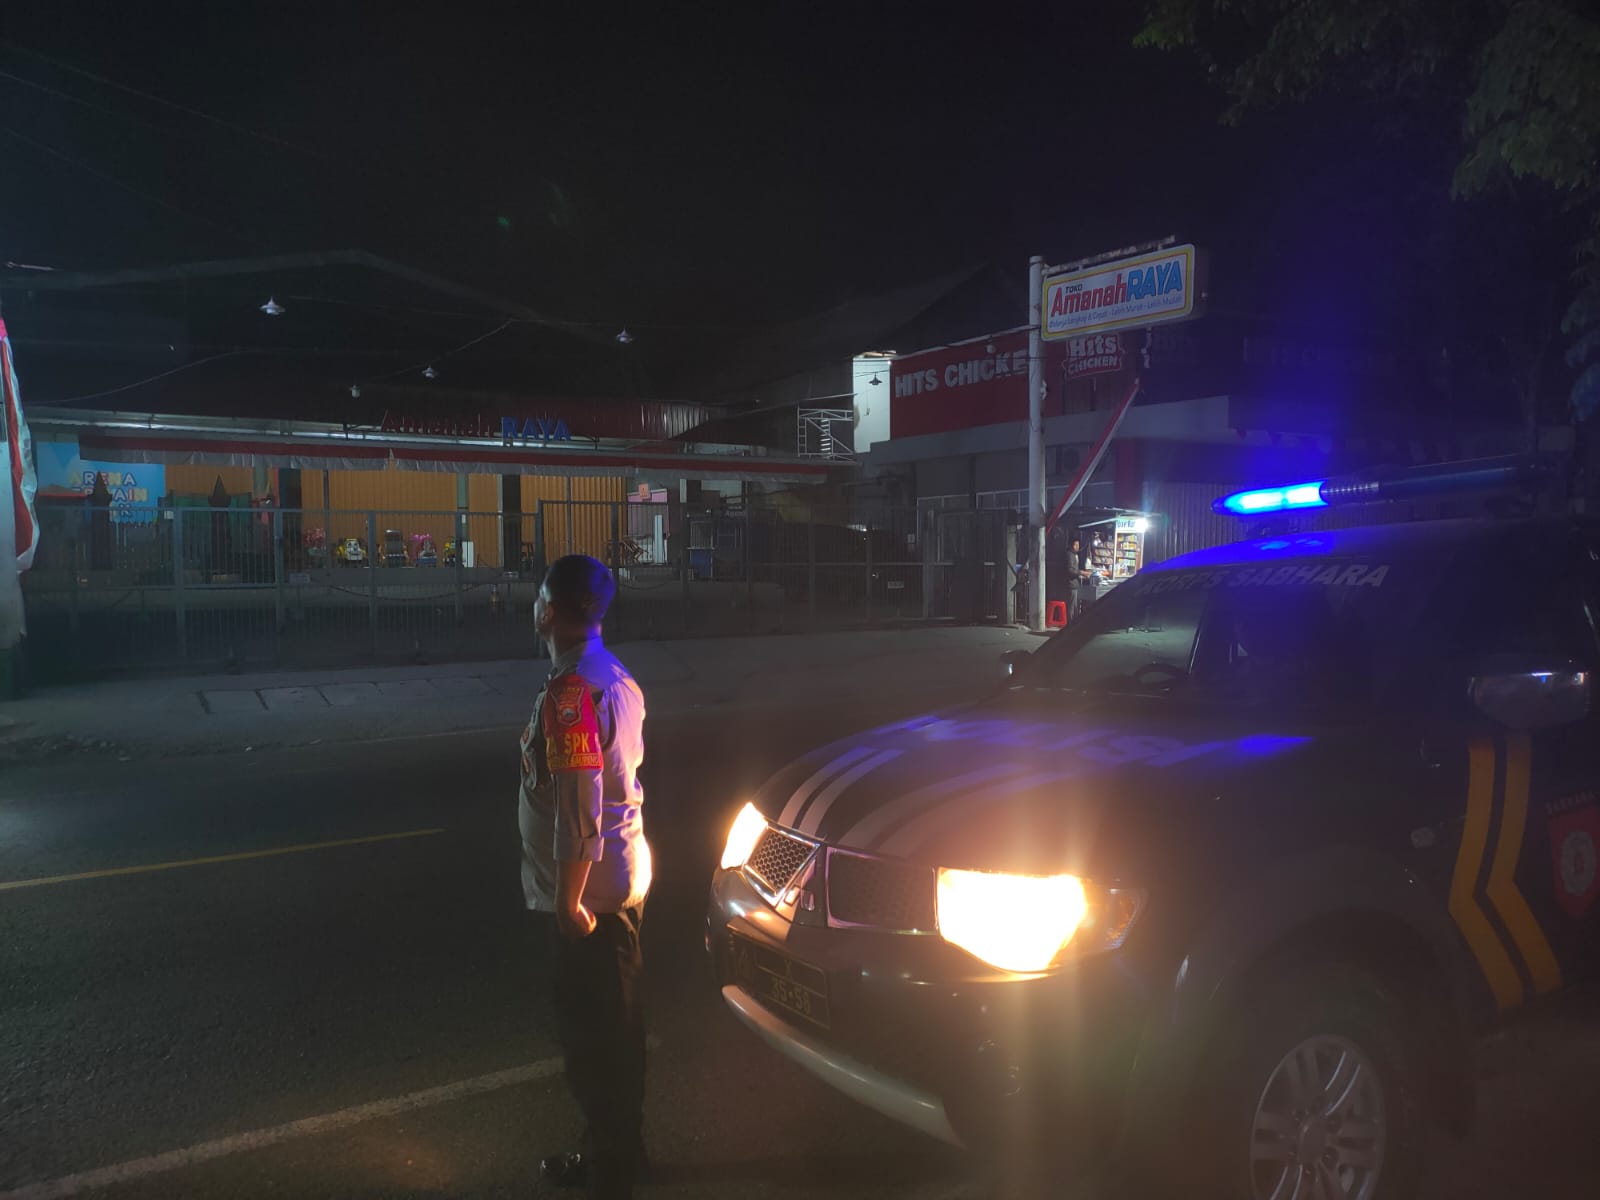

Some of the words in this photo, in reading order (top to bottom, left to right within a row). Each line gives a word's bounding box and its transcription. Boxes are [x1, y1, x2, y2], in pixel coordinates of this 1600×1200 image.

[1050, 273, 1127, 317] Amanah
[1127, 261, 1183, 300] RAYA
[1065, 283, 1083, 293] TOKO
[1070, 336, 1117, 357] Hits
[1067, 355, 1118, 375] CHICKEN
[895, 368, 938, 398] HITS
[501, 414, 571, 441] RAYA
[1228, 564, 1391, 588] SABHARA
[564, 732, 590, 754] SPK
